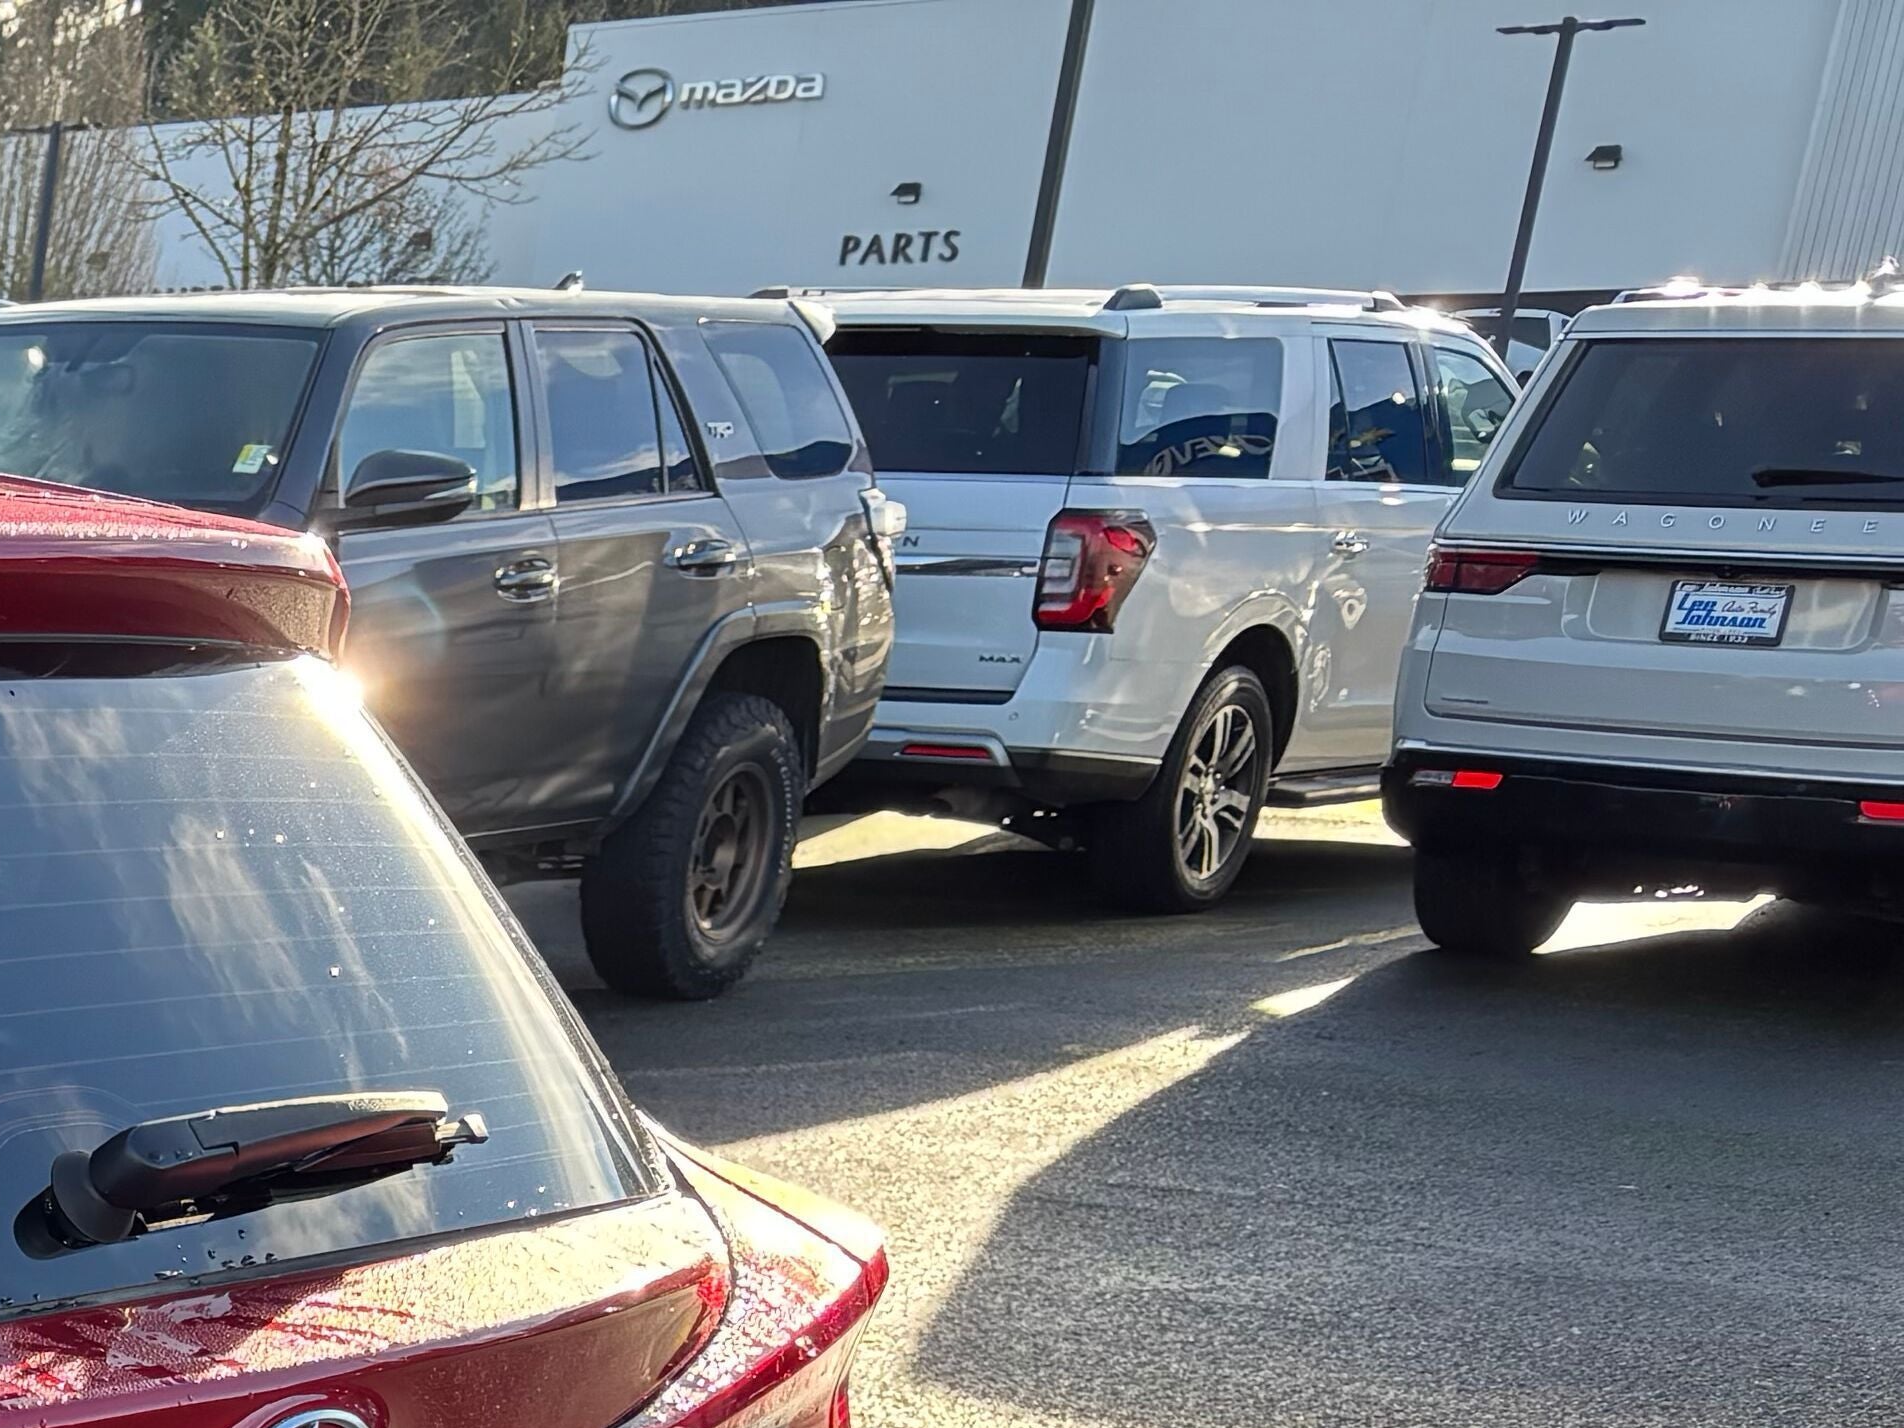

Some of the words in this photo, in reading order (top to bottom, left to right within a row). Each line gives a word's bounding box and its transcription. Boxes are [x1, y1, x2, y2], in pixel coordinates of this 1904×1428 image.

[679, 73, 824, 105] mazda
[838, 229, 961, 266] PARTS
[1675, 610, 1766, 629] Johnson
